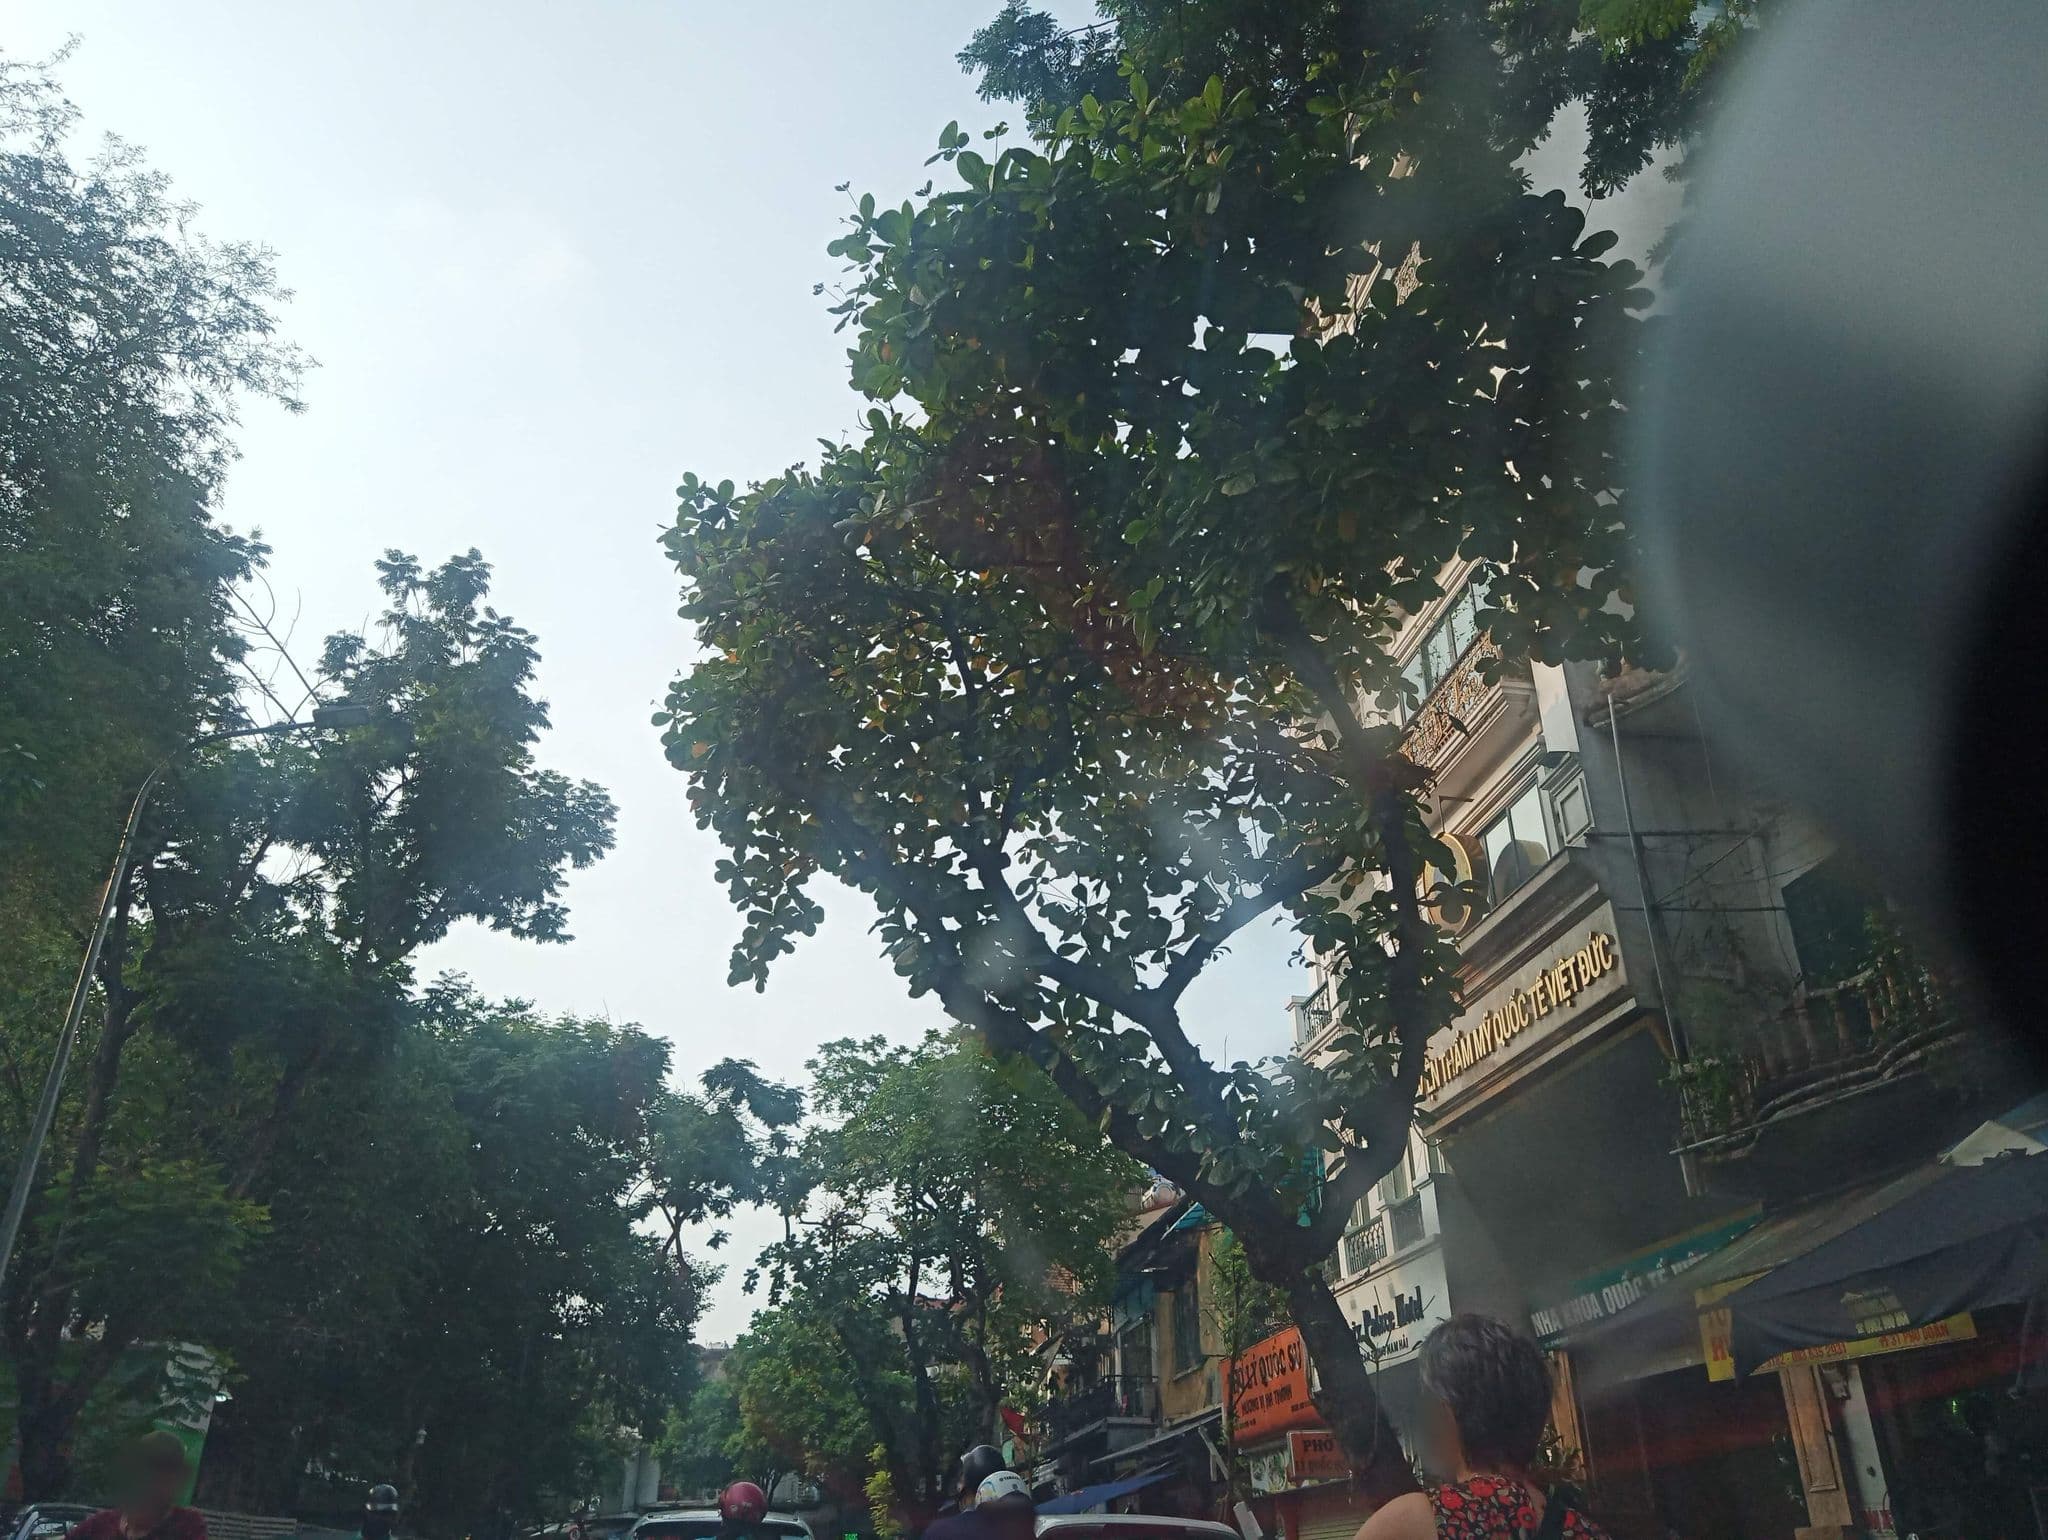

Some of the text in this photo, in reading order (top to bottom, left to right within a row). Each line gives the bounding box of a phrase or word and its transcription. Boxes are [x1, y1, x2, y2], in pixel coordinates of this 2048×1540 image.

[1438, 1032, 1475, 1082] THẨM
[1474, 1011, 1496, 1060] MỸ
[1493, 989, 1529, 1047] QUỐC
[1527, 970, 1548, 1021] TẾ
[1544, 959, 1578, 1007] VIỆT
[1576, 932, 1613, 986] ĐỨC
[1531, 1307, 1562, 1338] NHA
[1602, 1270, 1644, 1314] QUỐC
[1258, 1338, 1287, 1387] QUỐC
[1303, 1435, 1334, 1453] PHỞ
